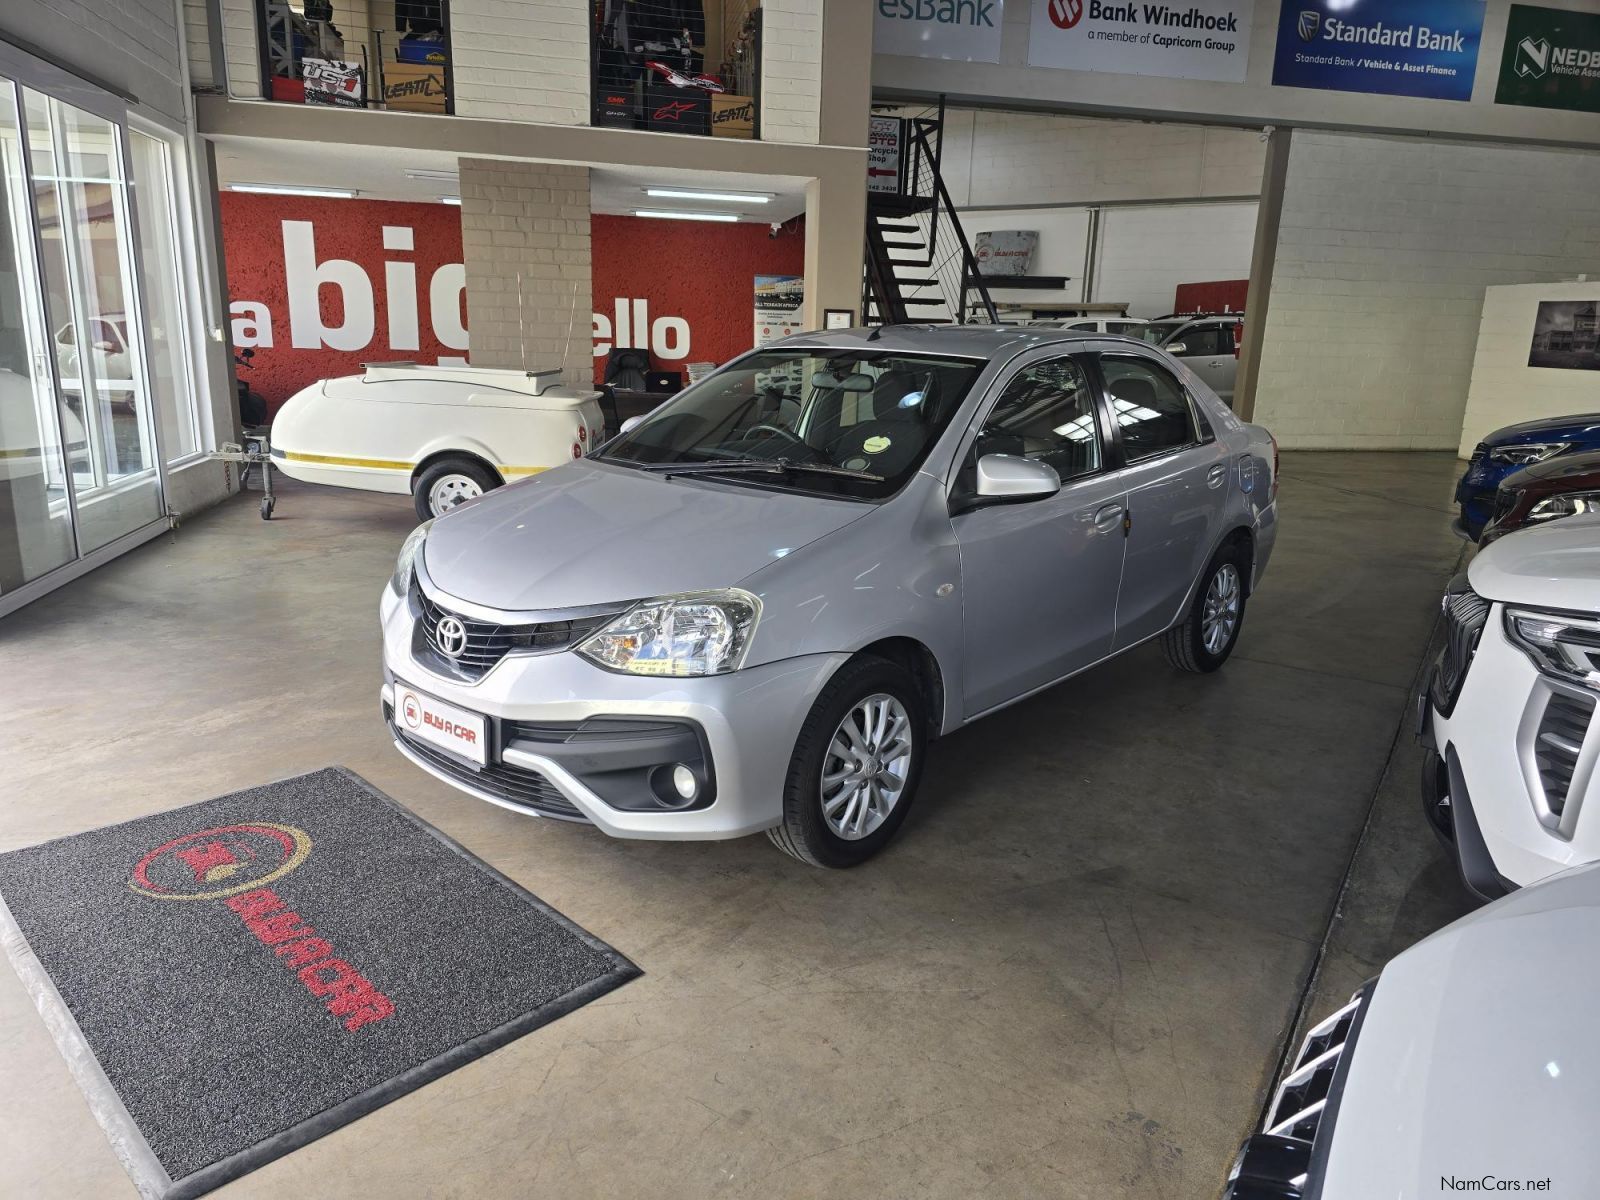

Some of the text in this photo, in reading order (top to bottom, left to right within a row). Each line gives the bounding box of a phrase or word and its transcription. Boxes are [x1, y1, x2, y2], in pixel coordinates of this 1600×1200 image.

[1088, 0, 1239, 32] Bank Windhoek
[1087, 29, 1236, 54] a member of Capricorn Group
[1323, 17, 1465, 53] Standard Bank
[1295, 53, 1334, 65] Standard
[1334, 56, 1355, 67] Bank
[1363, 59, 1393, 70] Vehicle
[1394, 62, 1400, 71] &
[1402, 62, 1425, 73] Asset
[1425, 64, 1457, 76] Finance
[1551, 47, 1600, 68] NEDB
[1551, 63, 1580, 76] Vehicle
[230, 299, 274, 349] a
[423, 710, 477, 744] BUY A CAR
[297, 958, 396, 1033] CAR
